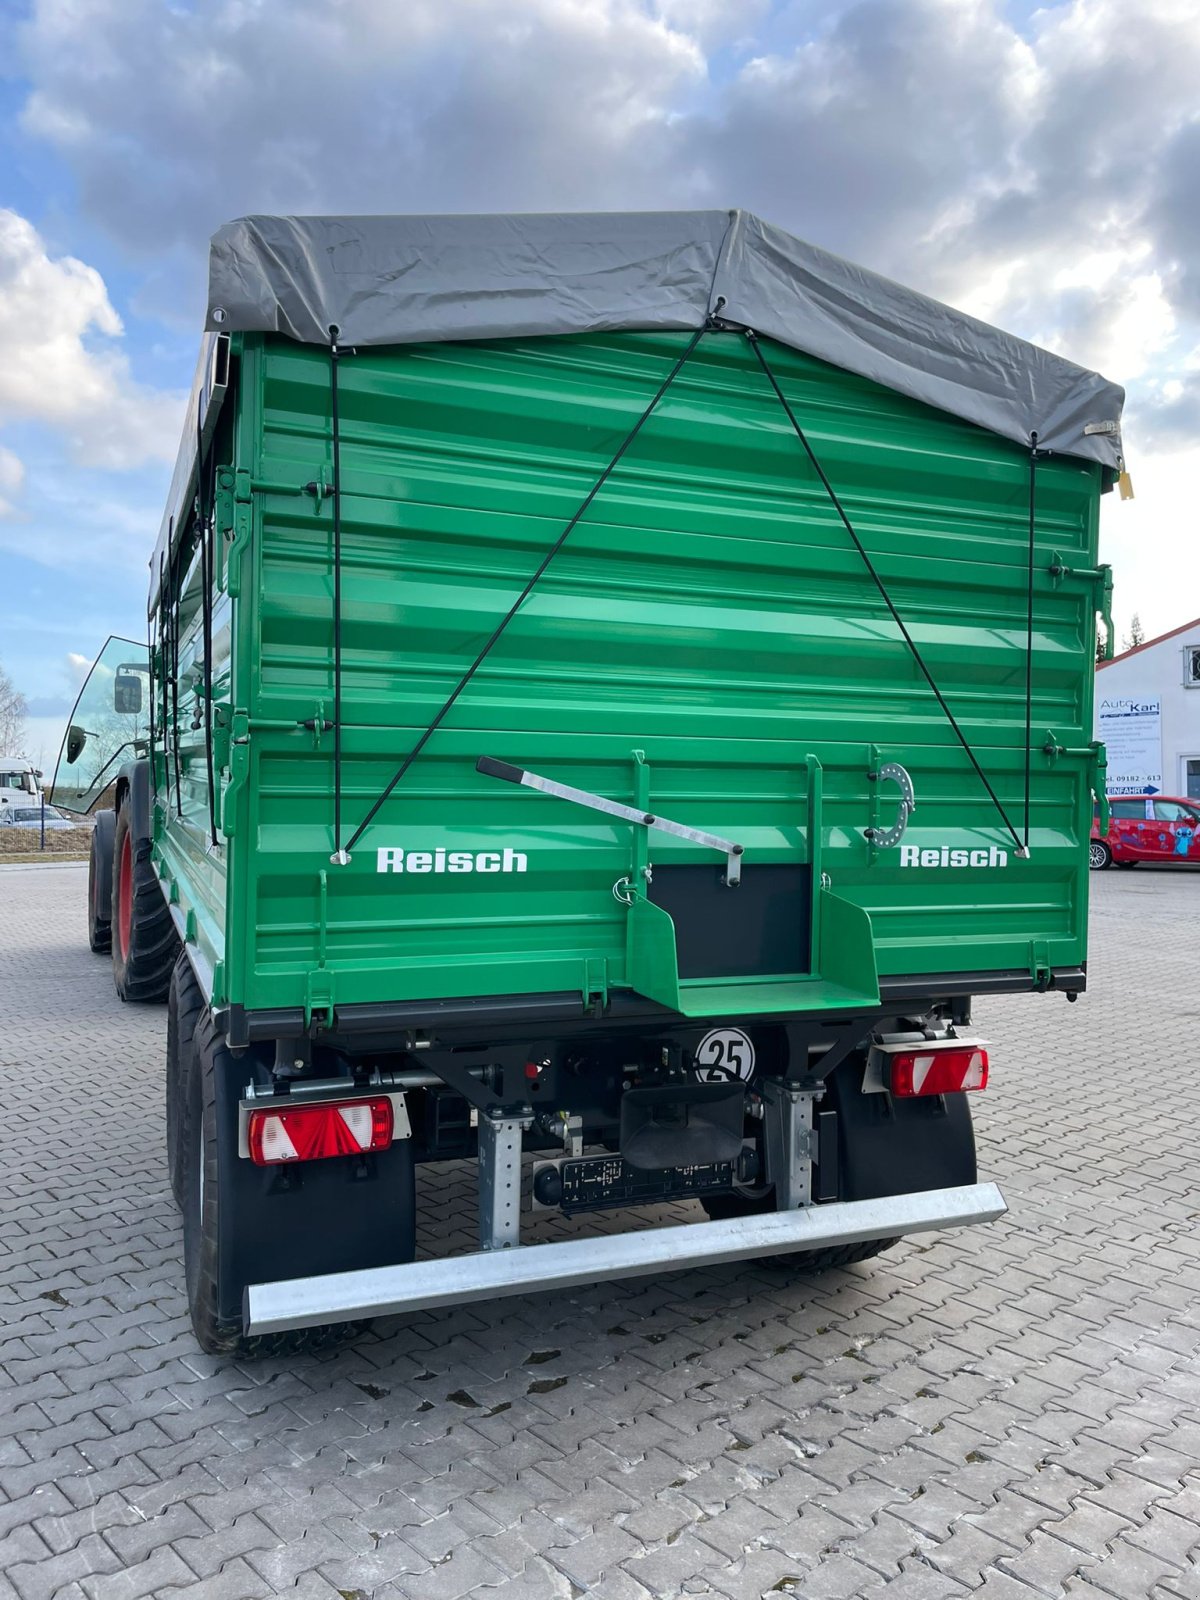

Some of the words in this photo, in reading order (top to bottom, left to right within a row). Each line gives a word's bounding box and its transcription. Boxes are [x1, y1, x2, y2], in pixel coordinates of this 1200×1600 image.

[1100, 700, 1133, 708] Auto
[1130, 702, 1159, 712] Karl
[1107, 787, 1144, 795] EINFAHRT
[376, 847, 528, 873] Reisch
[900, 845, 1008, 867] Reisch
[706, 1040, 744, 1081] 25
